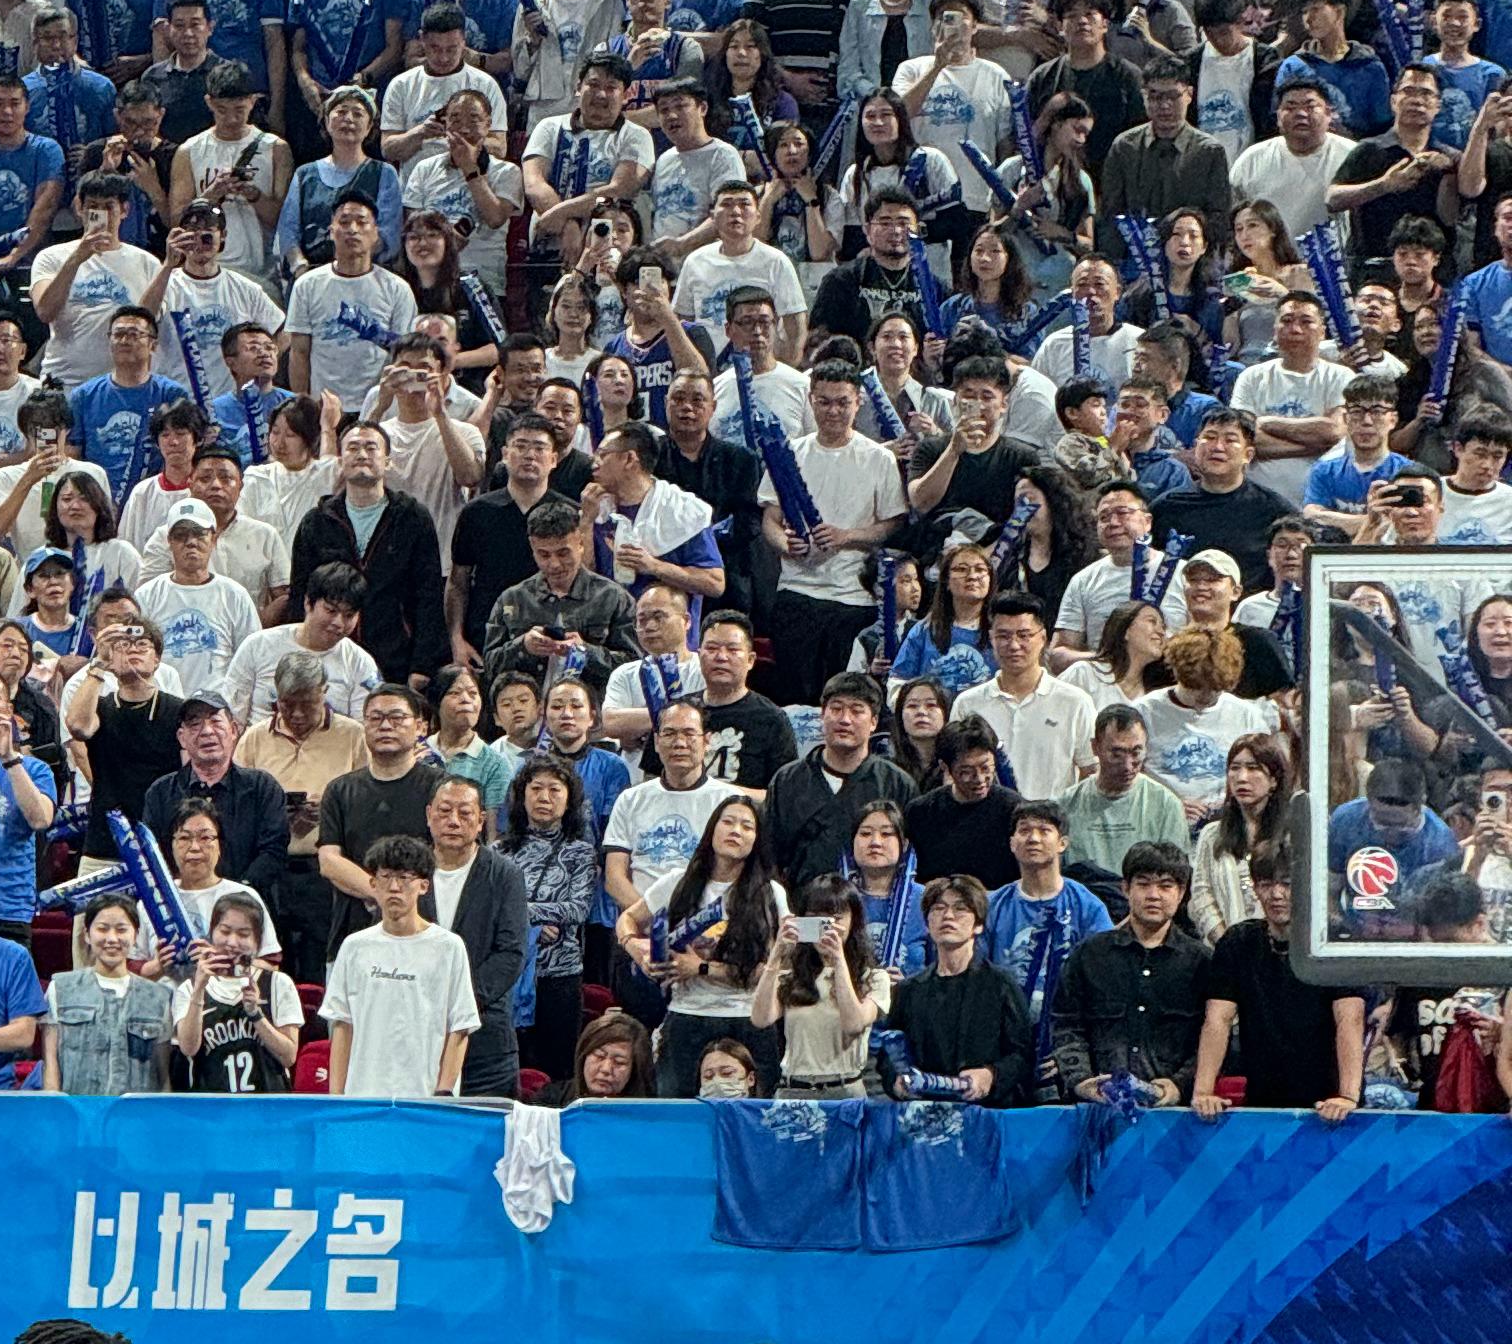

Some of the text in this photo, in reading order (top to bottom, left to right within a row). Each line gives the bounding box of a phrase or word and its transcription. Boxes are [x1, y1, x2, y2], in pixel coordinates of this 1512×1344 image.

[203, 1019, 264, 1056] ROOKL
[223, 1052, 256, 1094] 12
[67, 1188, 405, 1311] 以城之名
